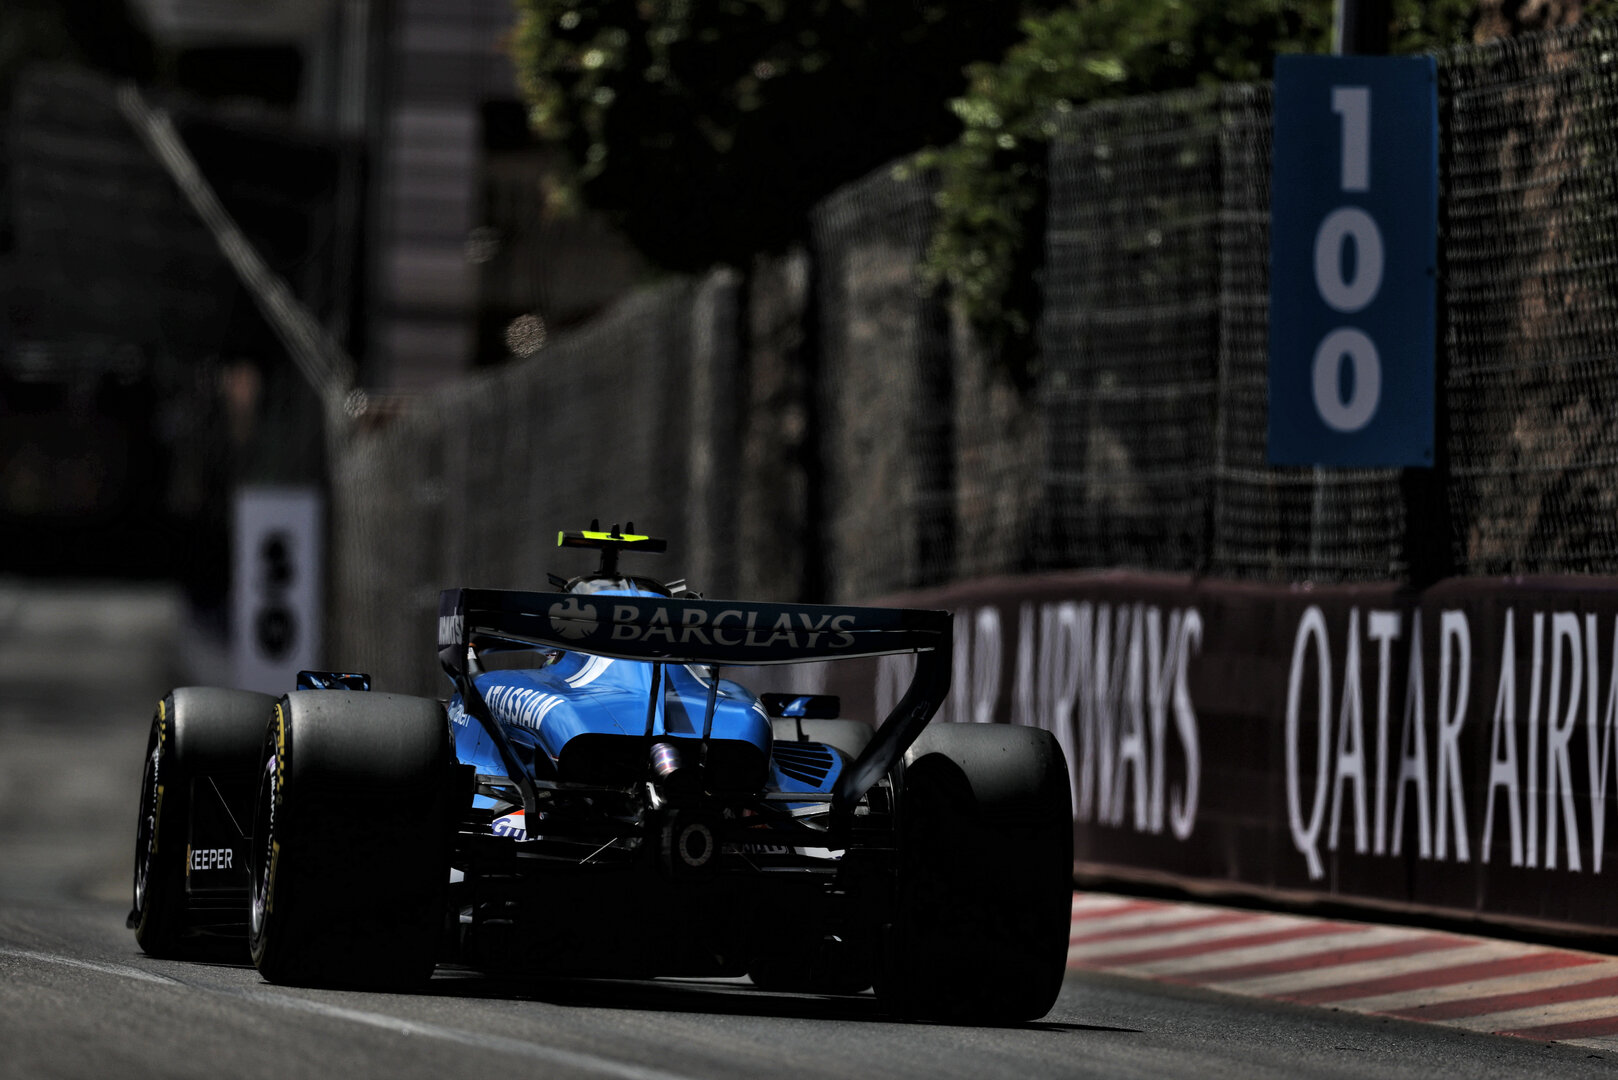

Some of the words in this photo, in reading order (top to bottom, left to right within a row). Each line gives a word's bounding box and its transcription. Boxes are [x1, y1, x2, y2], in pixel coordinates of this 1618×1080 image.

[1310, 86, 1385, 433] 100
[611, 604, 857, 650] BARCLAYS
[485, 686, 565, 731] ATLASSIAN
[1285, 604, 1471, 880] QATAR
